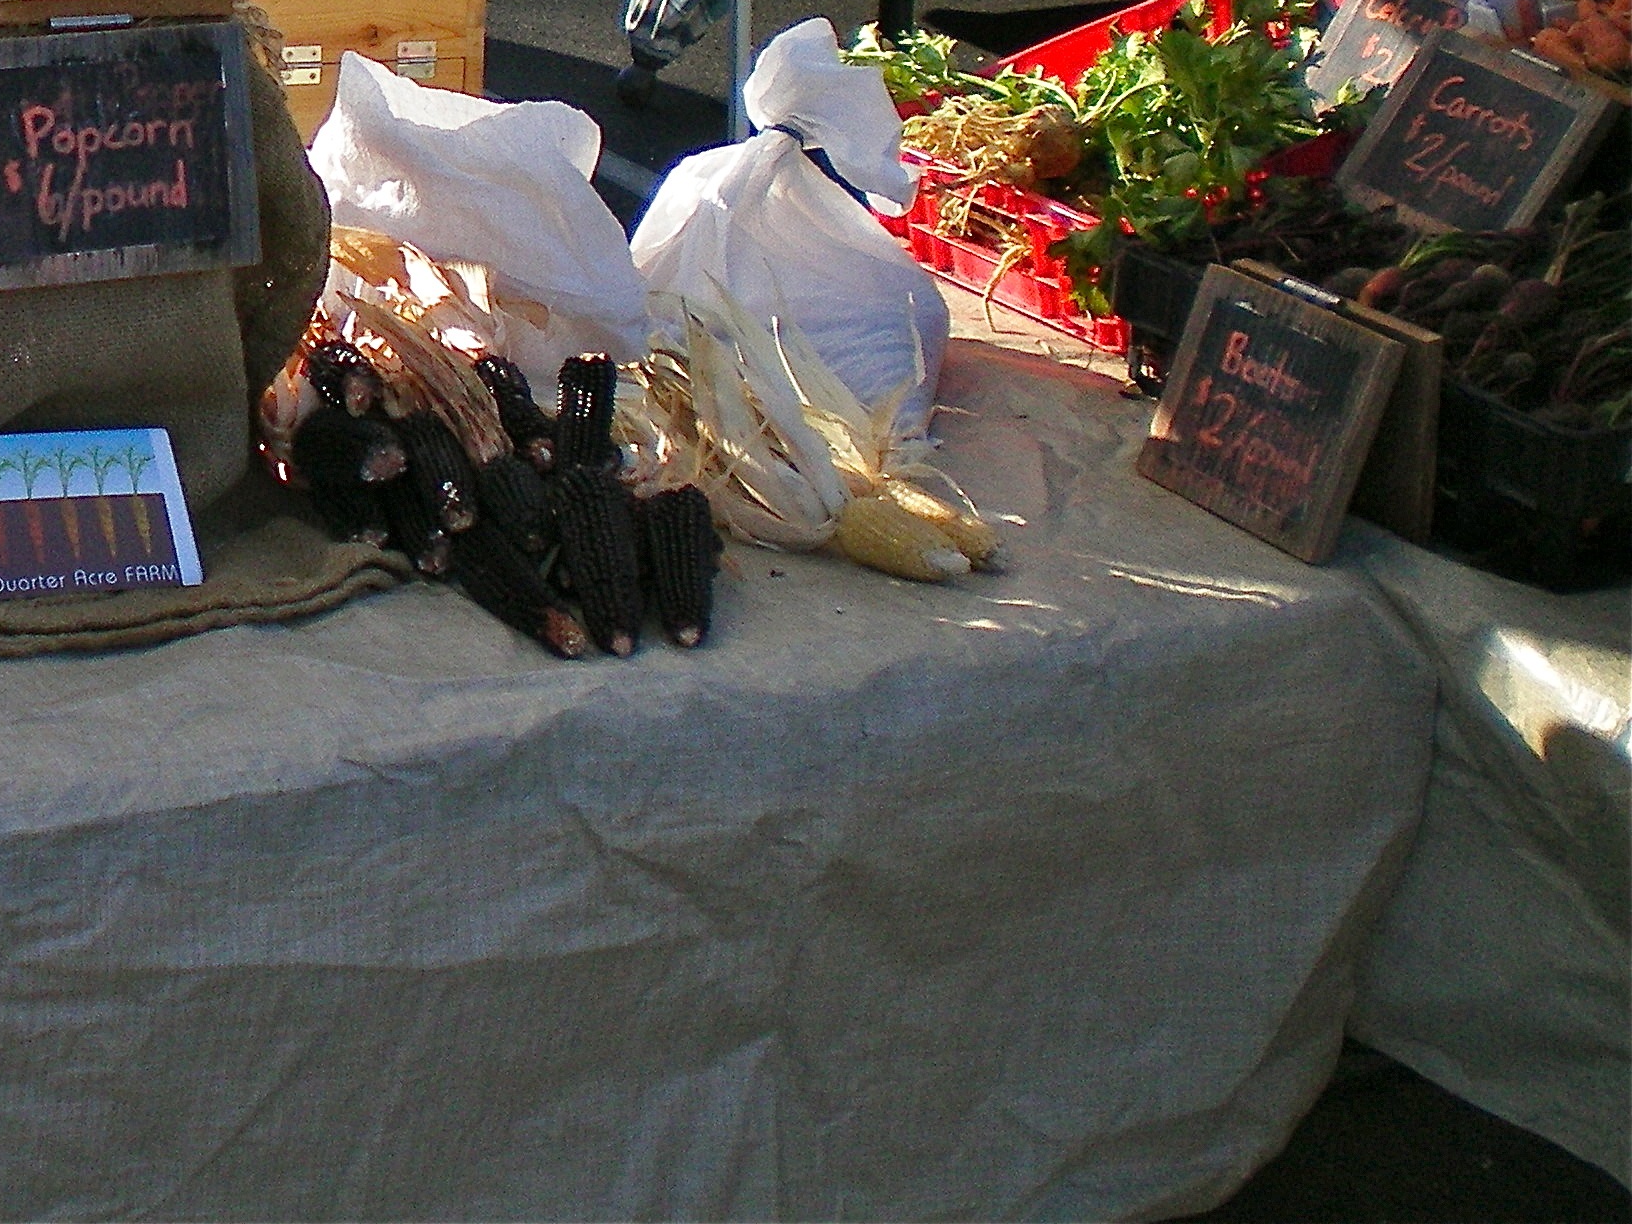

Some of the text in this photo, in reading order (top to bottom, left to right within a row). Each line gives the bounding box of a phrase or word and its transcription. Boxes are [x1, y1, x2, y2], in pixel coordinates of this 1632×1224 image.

[21, 104, 195, 167] Popcorn
[1429, 76, 1535, 151] Carrots
[74, 569, 117, 587] Acre
[124, 563, 180, 583] FARM
